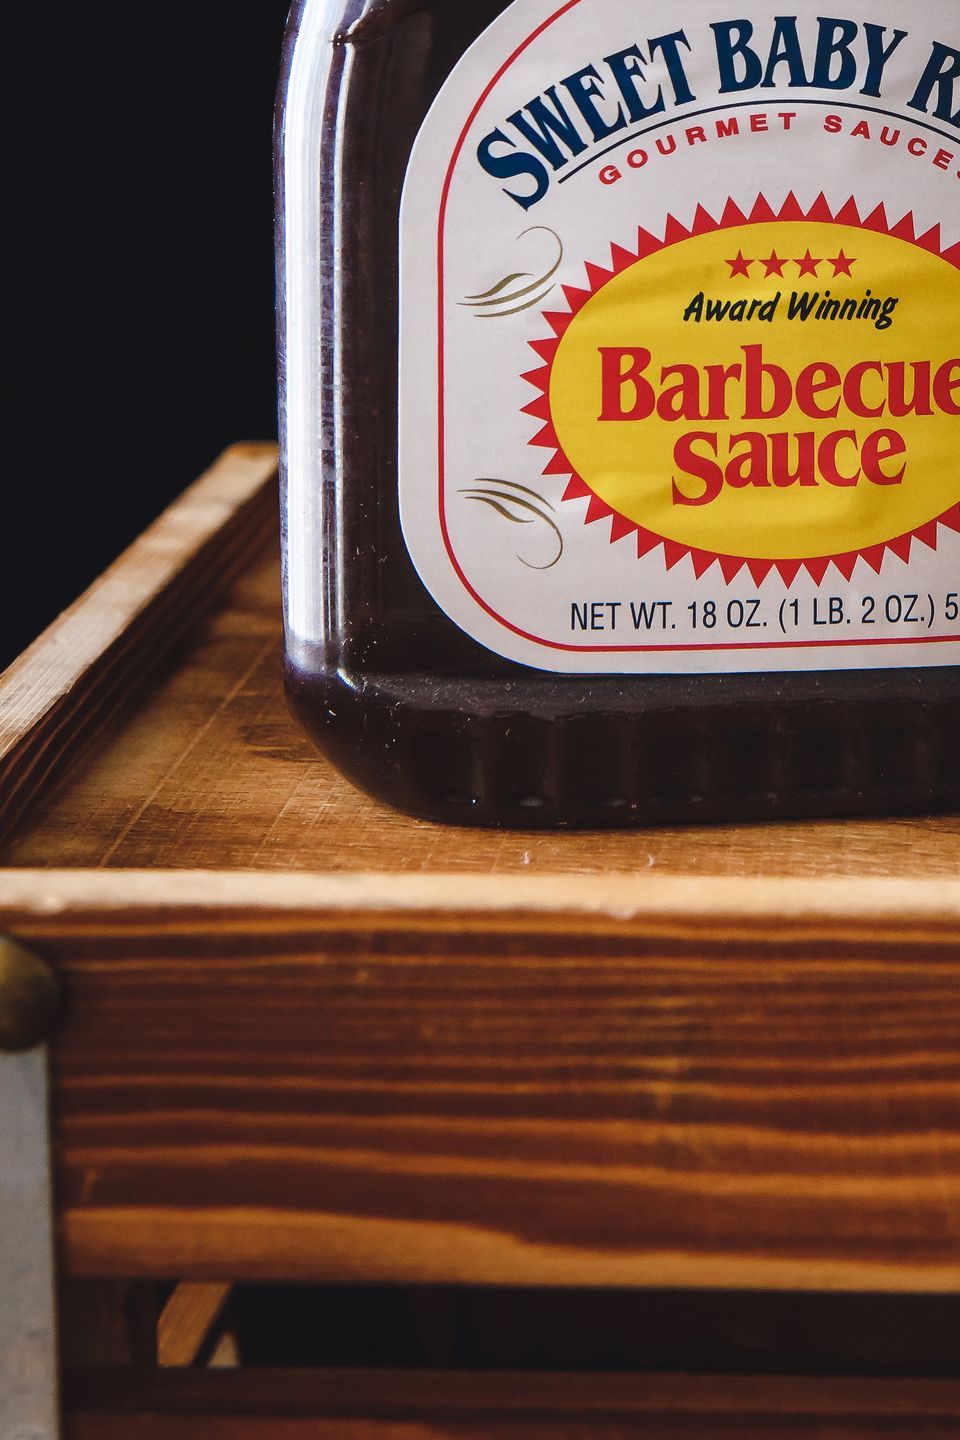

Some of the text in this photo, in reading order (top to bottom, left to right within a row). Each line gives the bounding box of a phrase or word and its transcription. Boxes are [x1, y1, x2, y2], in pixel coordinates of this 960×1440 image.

[476, 28, 696, 211] SWEET
[709, 16, 908, 98] BABY
[598, 112, 798, 186] GOURMET
[683, 289, 900, 330] Award Winning
[671, 428, 908, 506] Sauce
[569, 601, 621, 631] NET
[629, 601, 677, 630] WT.
[687, 600, 717, 628] 18
[725, 599, 769, 628] OZ.
[778, 599, 800, 633] (1
[812, 598, 852, 626] LB.
[862, 597, 875, 625] 2
[884, 595, 935, 628] OZ.
